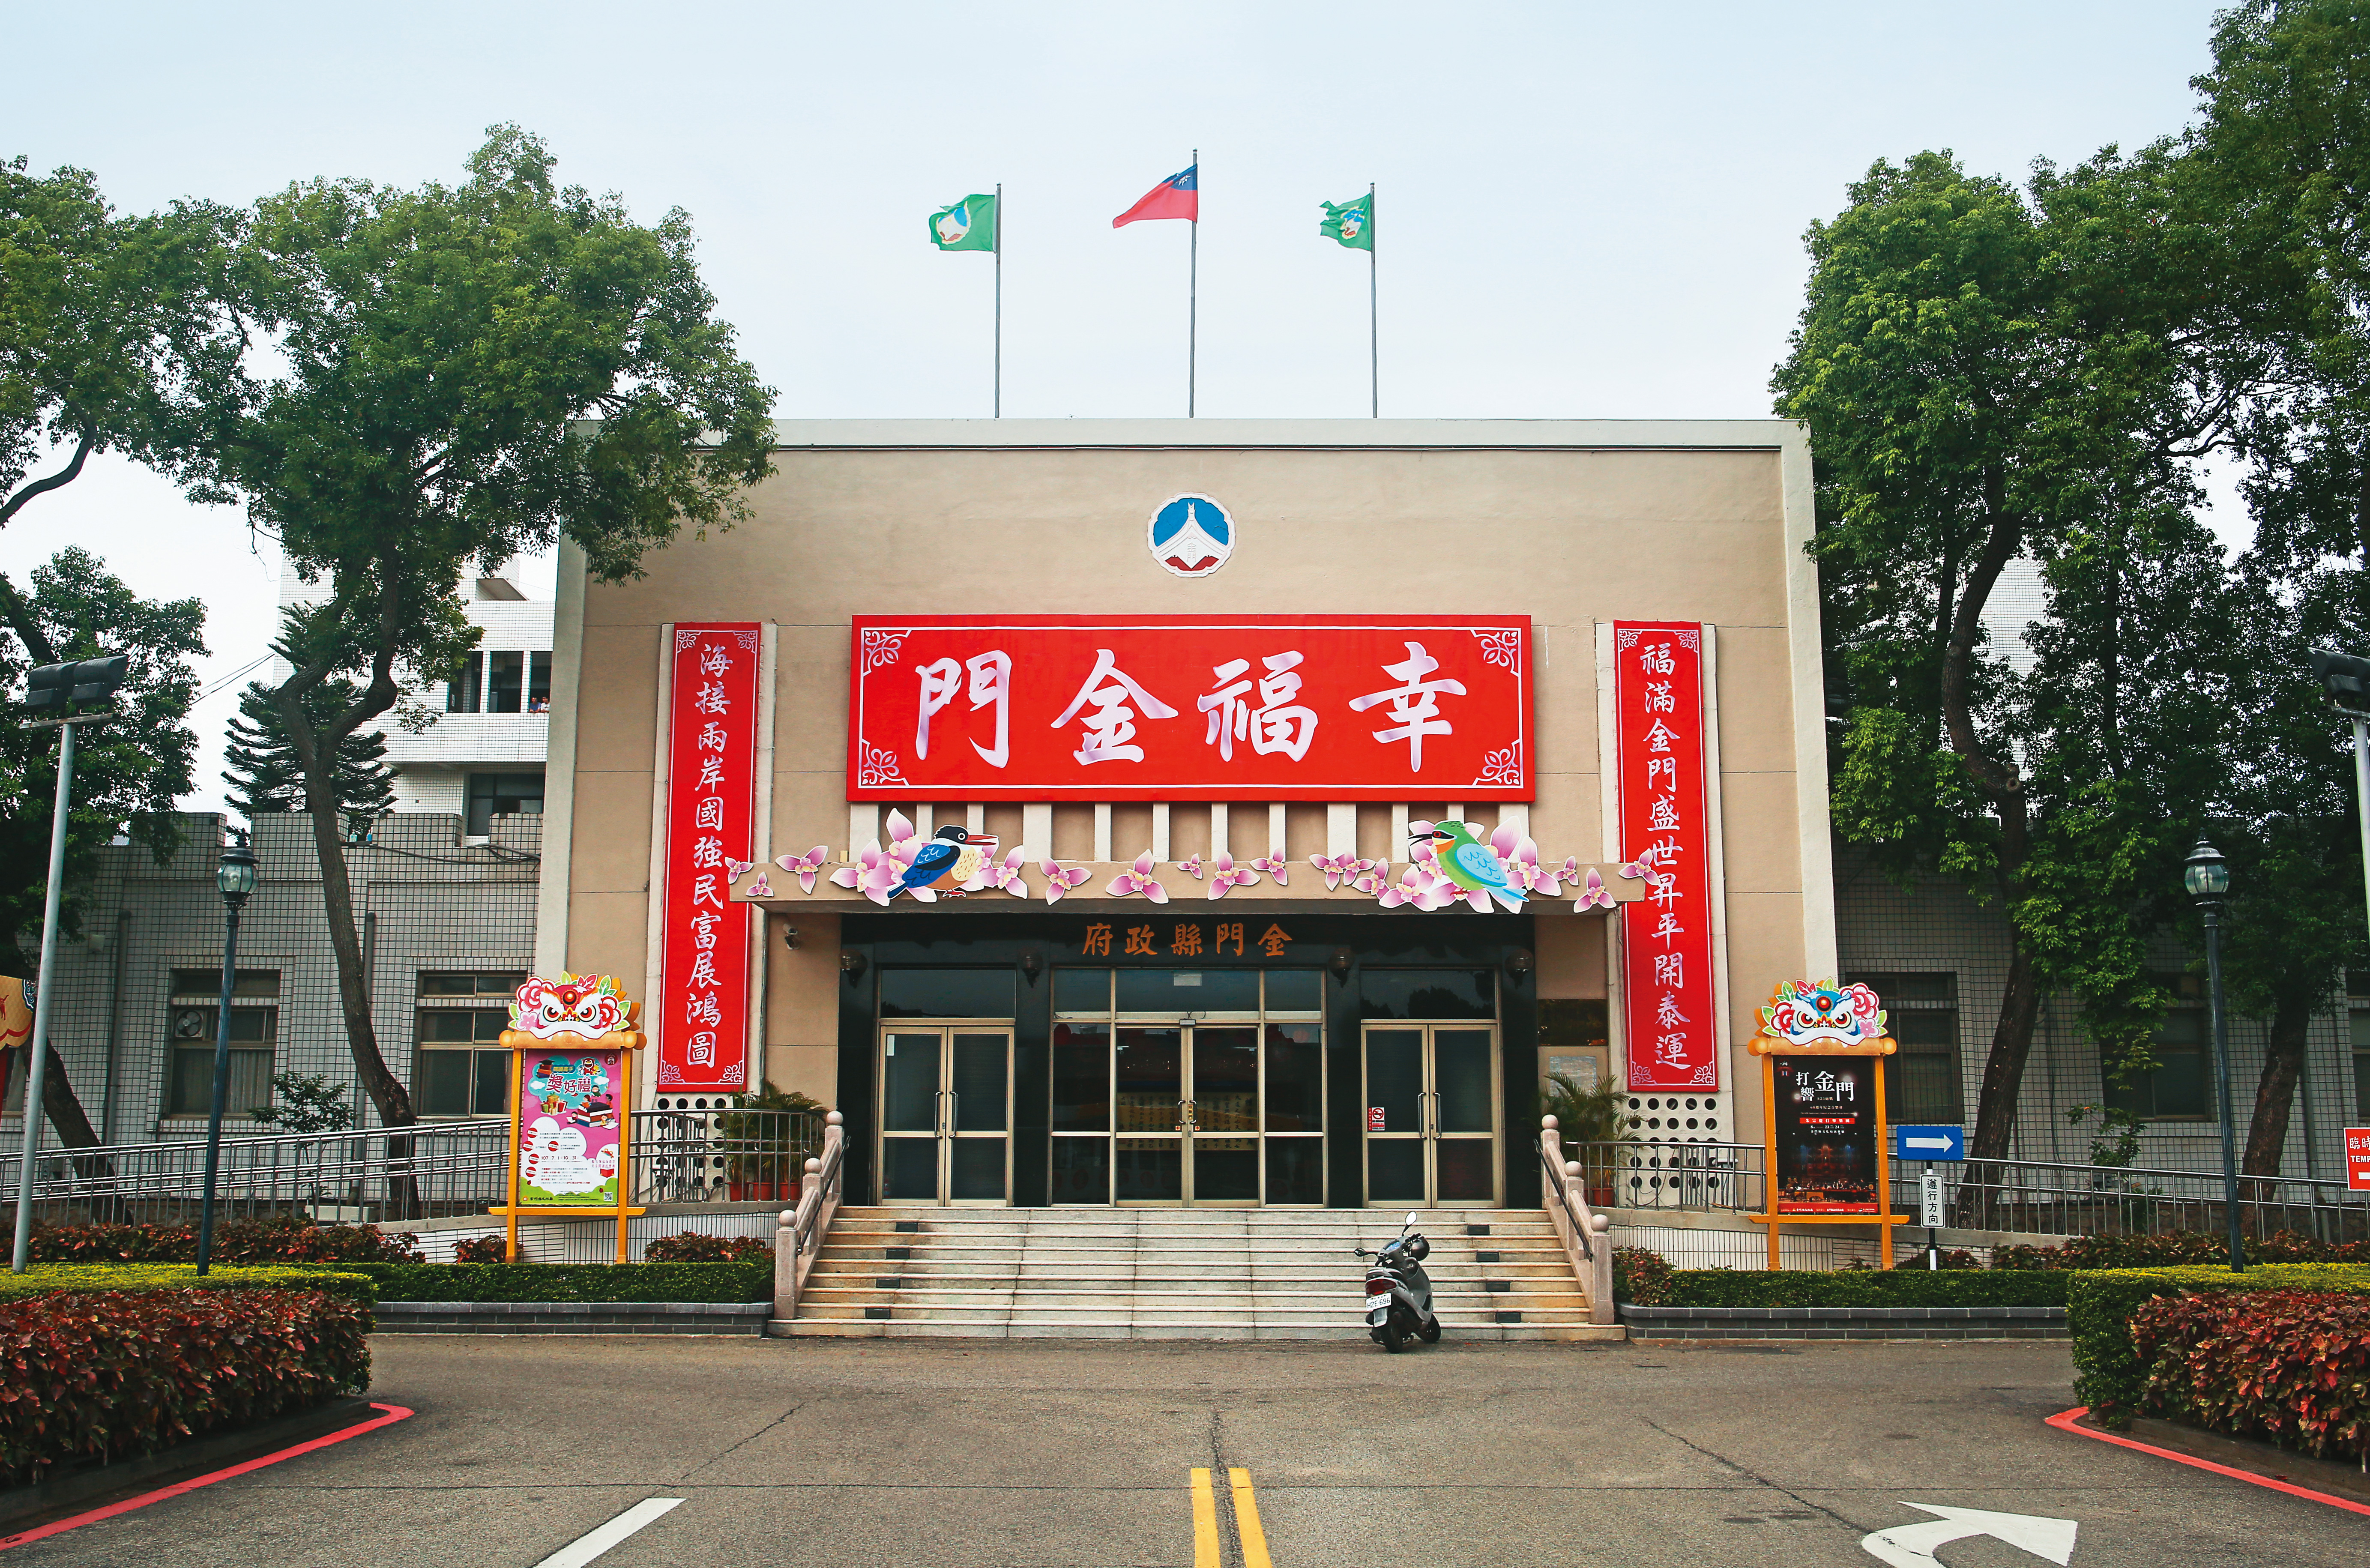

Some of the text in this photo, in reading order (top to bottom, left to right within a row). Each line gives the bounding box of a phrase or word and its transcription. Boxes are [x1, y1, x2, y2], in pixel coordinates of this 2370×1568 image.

[916, 641, 1467, 773] 幸福金門
[686, 643, 733, 1068] 海接兩岸國強民富展鴻圖
[1640, 643, 1691, 1069] 福滿金門盛世昇平開泰運
[1083, 923, 1293, 957] 金門縣政府
[546, 1074, 591, 1094] 獎好禮
[1927, 1179, 1938, 1224] 遵行方向
